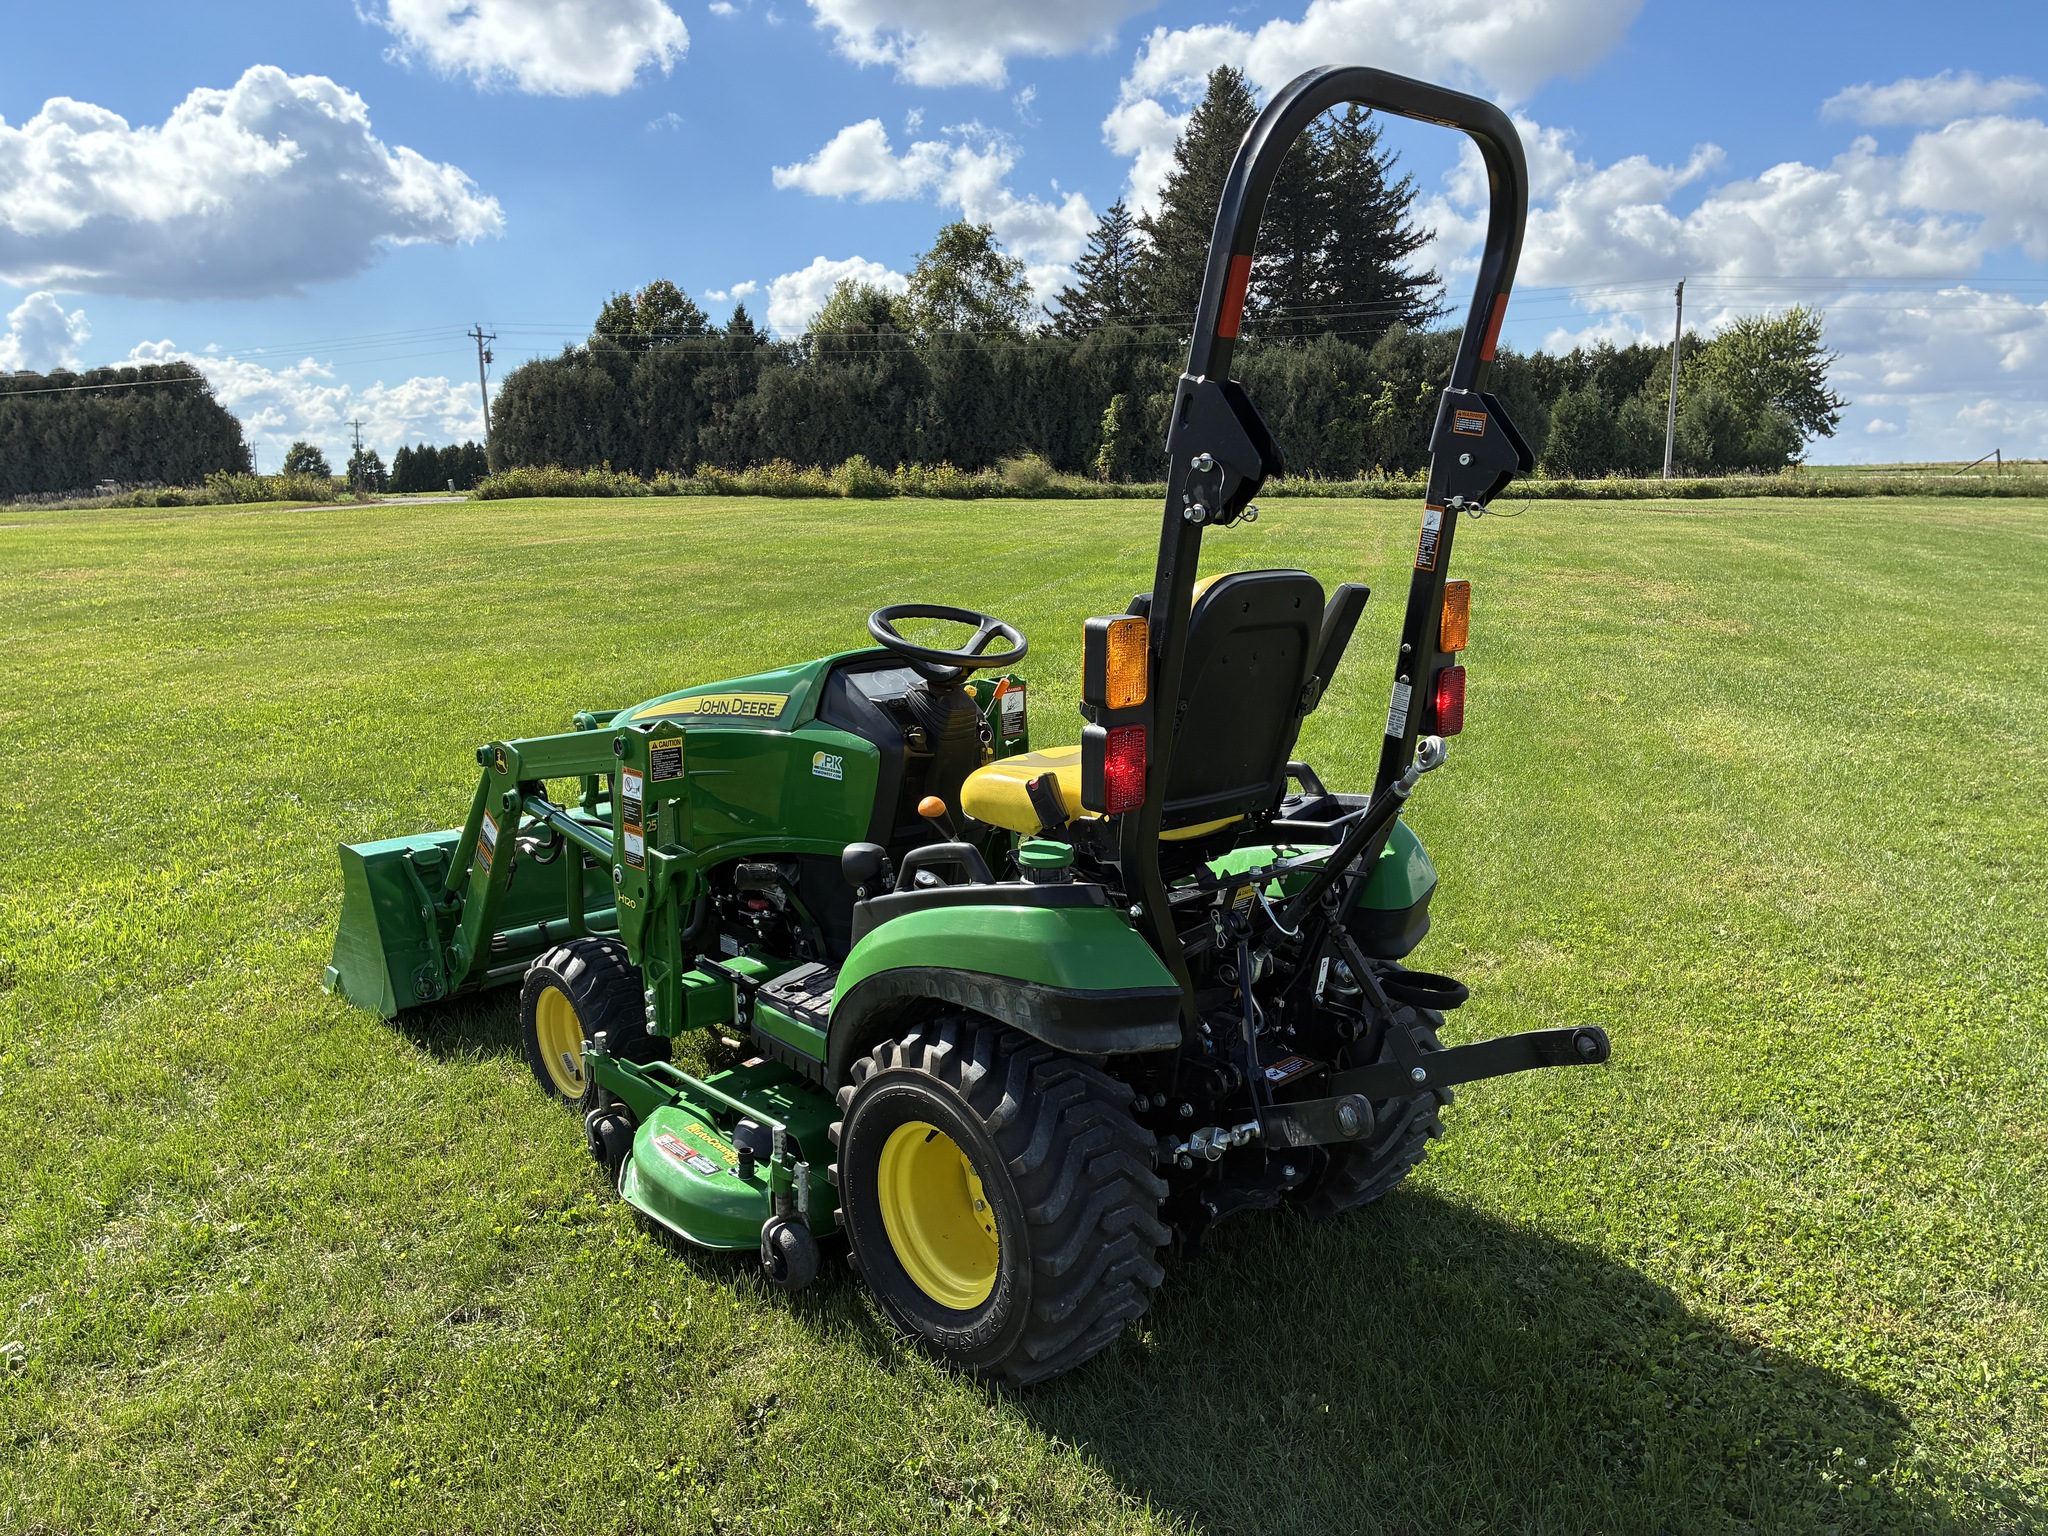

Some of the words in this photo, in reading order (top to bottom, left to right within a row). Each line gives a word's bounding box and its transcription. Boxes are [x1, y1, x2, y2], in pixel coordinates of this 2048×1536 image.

[694, 699, 730, 713] JOHN
[731, 699, 777, 715] DEERE
[658, 739, 681, 748] CAUTION
[825, 755, 842, 769] PK
[646, 819, 658, 832] 25
[931, 1272, 1012, 1352] CARLISLE
